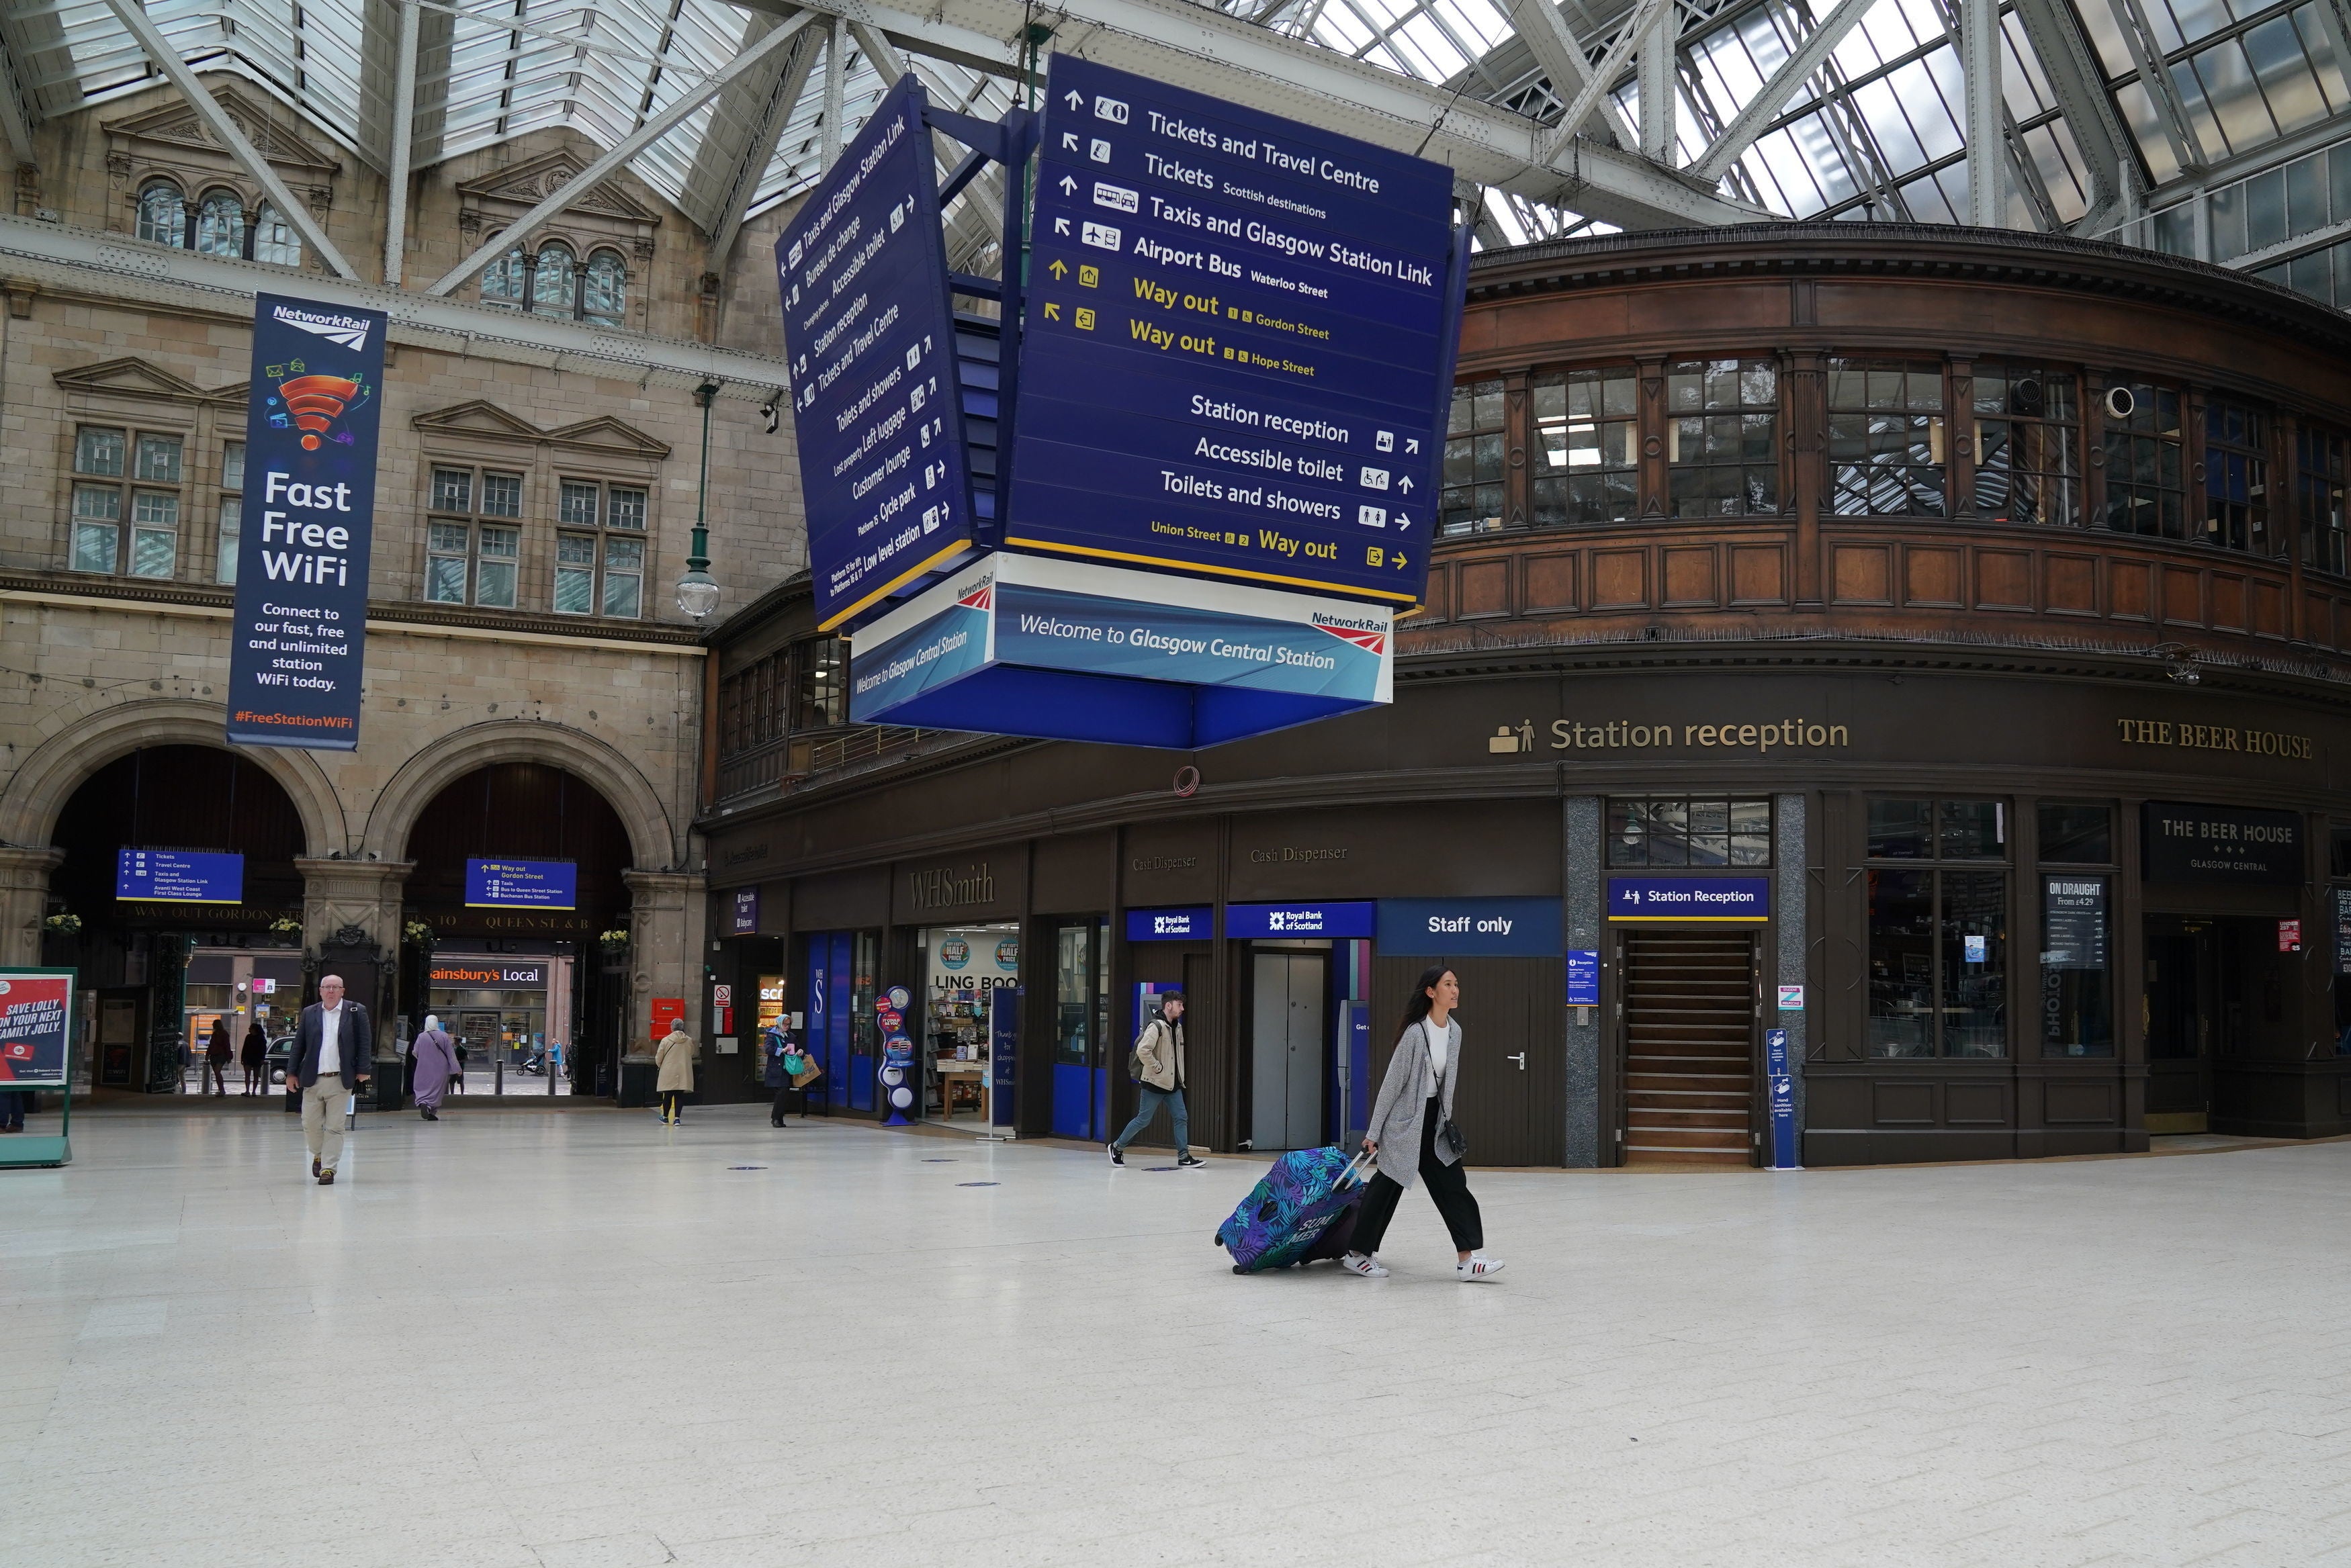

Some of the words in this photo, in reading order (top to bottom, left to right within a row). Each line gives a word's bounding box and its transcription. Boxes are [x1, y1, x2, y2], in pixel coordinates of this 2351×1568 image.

[1148, 111, 1216, 148] Tickets
[1223, 130, 1255, 160] and
[1263, 142, 1315, 176] Travel
[1321, 161, 1379, 194] Centre
[803, 220, 820, 249] Taxis
[821, 205, 832, 231] and
[832, 175, 860, 214] Glasgow
[860, 138, 888, 179] Station
[889, 114, 905, 146] Link
[1145, 152, 1213, 189] Tickets
[1223, 182, 1264, 204] Scottish
[1267, 193, 1326, 220] destinations
[806, 258, 827, 289] Bureau
[828, 243, 836, 263] de
[837, 216, 860, 252] change
[1151, 196, 1201, 228] Taxis
[1206, 214, 1241, 238] and
[1247, 222, 1324, 260] Glasgow
[1330, 243, 1392, 276] Station
[1398, 261, 1432, 287] Link
[832, 250, 866, 298] Accessible
[867, 228, 885, 261] toilet
[1134, 236, 1202, 271] Airport
[1209, 255, 1241, 278] Bus
[1250, 270, 1295, 291] Waterloo
[1298, 281, 1328, 299] Street
[273, 306, 370, 331] NetworkRail
[1134, 277, 1178, 310] Way
[1184, 291, 1219, 316] out
[1256, 314, 1295, 334] Gordon
[1297, 323, 1329, 340] Street
[814, 324, 836, 359] Station
[836, 293, 868, 334] reception
[818, 358, 841, 391] Tickets
[841, 345, 853, 369] and
[853, 328, 874, 357] Travel
[875, 304, 899, 337] Centre
[1130, 319, 1174, 351] Way
[1180, 333, 1215, 356] out
[1252, 353, 1280, 371] Hope
[1282, 360, 1315, 377] Street
[836, 405, 858, 433] Toilets
[858, 390, 871, 414] and
[871, 366, 901, 402] showers
[862, 427, 876, 453] Left
[876, 406, 905, 441] luggage
[1191, 394, 1259, 427] Station
[1265, 411, 1349, 445] reception
[852, 465, 885, 500] Customer
[885, 445, 910, 475] lounge
[1194, 436, 1292, 472] Accessible
[1296, 451, 1343, 482] toilet
[265, 471, 351, 512] Fast
[879, 494, 897, 522] Cycle
[899, 483, 916, 511] park
[1161, 471, 1222, 500] Toilets
[1228, 481, 1261, 506] and
[1266, 490, 1341, 520] showers
[263, 510, 349, 550] Free
[1151, 521, 1185, 537] Union
[1187, 526, 1221, 541] Street
[1259, 530, 1299, 559] Way
[1304, 540, 1337, 560] out
[863, 551, 877, 572] Low
[877, 537, 895, 563] level
[895, 524, 920, 553] station
[262, 550, 347, 586] WiFi
[957, 571, 993, 600] NetworkRail
[263, 602, 320, 618] Connect
[324, 609, 339, 620] to
[1312, 612, 1387, 633] NetworkRail
[255, 622, 279, 633] our
[282, 622, 313, 637] fast,
[317, 625, 345, 637] free
[1020, 614, 1102, 641] Welcome
[1107, 626, 1124, 643] to
[1130, 627, 1206, 655] Glasgow
[1210, 638, 1272, 663] Central
[1275, 647, 1335, 670] Station
[249, 639, 277, 650] and
[281, 641, 347, 655] unlimited
[272, 657, 322, 671] station
[856, 675, 881, 694] Welcome
[882, 668, 887, 683] to
[889, 655, 916, 679] Glasgow
[916, 639, 940, 666] Central
[941, 631, 967, 655] Station
[257, 673, 289, 686] WiFi
[293, 676, 337, 692] today.
[235, 711, 353, 729] #FreeStationWiFi
[1551, 719, 1672, 749] Station
[1685, 719, 1848, 752] reception
[2118, 719, 2172, 745] THE
[2178, 724, 2239, 751] BEER
[2245, 730, 2312, 759] HOUSE
[2163, 819, 2193, 837] THE
[2201, 823, 2238, 839] BEER
[2244, 825, 2293, 843] HOUSE
[1133, 858, 1152, 870] Cash
[1154, 856, 1196, 870] Dispenser
[1251, 849, 1278, 863] Cash
[1284, 847, 1347, 863] Dispenser
[2190, 859, 2231, 870] GLASGOW
[2233, 861, 2267, 871] CENTRAL
[910, 862, 994, 911] WHSmith
[1648, 890, 1691, 903] Station
[1695, 890, 1754, 905] Reception
[2049, 882, 2061, 895] ON
[2063, 883, 2100, 896] DRAUGHT
[135, 906, 163, 917] WAY
[172, 907, 204, 919] OUT
[208, 908, 272, 921] GORDON
[1286, 912, 1304, 921] Royal
[1305, 911, 1322, 920] Bank
[2057, 897, 2074, 906] From
[2076, 898, 2094, 907] £4.29
[1165, 916, 1178, 925] Royal
[1179, 915, 1190, 923] Bank
[1171, 925, 1190, 933] Scotland
[1286, 921, 1293, 930] of
[1294, 921, 1322, 930] Scotland
[1428, 917, 1470, 932] Staff
[1477, 917, 1513, 935] only
[946, 946, 964, 955] HALF
[504, 969, 538, 981] Local
[6, 1003, 31, 1015] SAVE
[32, 999, 60, 1012] LOLLY
[13, 1013, 38, 1026] YOUR
[39, 1009, 62, 1023] NEXT
[31, 1021, 60, 1035] JOLLY.
[1288, 1229, 1319, 1244] MER
[1299, 1214, 1333, 1232] SUM
